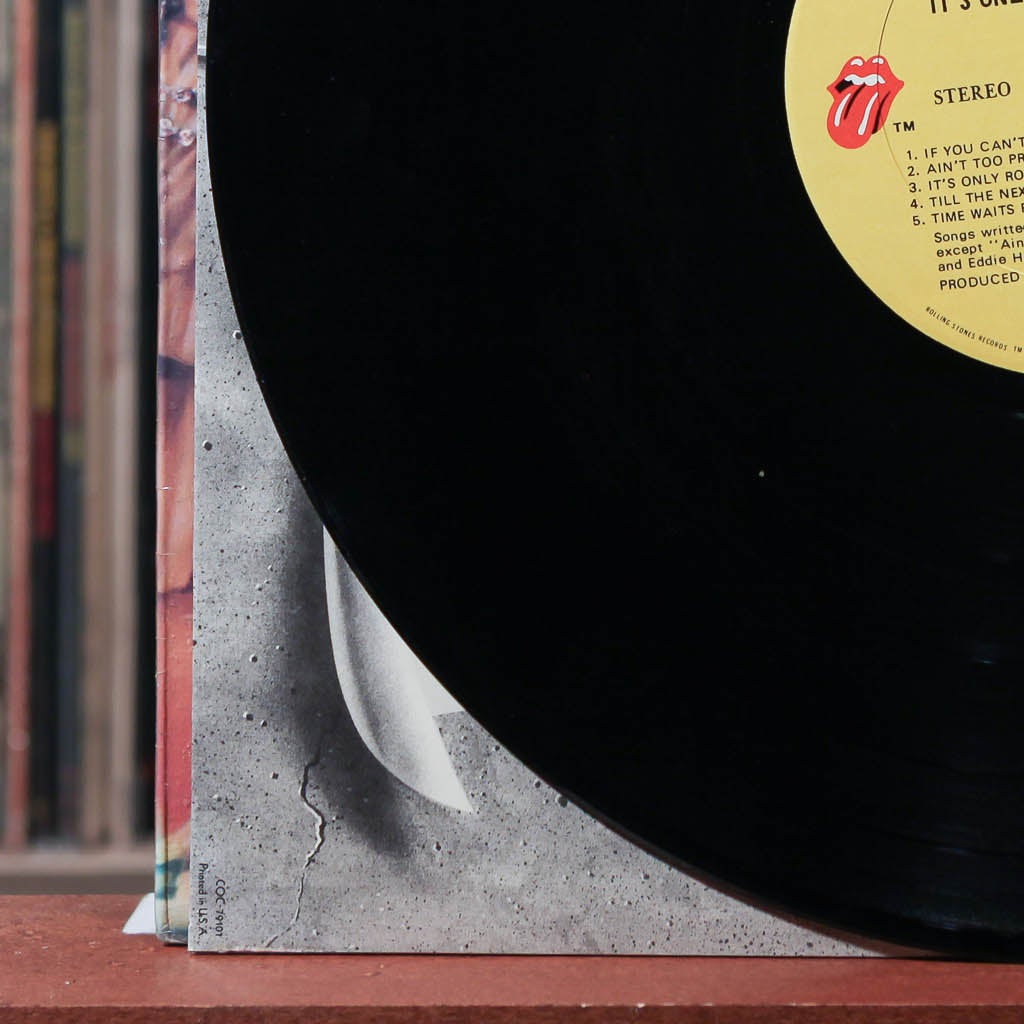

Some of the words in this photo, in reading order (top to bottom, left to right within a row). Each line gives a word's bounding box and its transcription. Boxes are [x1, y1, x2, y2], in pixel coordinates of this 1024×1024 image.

[934, 81, 1011, 105] STEREO
[893, 121, 915, 132] TM
[907, 150, 918, 160] 1.
[924, 147, 938, 158] IF
[943, 144, 973, 157] YOU
[907, 166, 920, 177] 2.
[927, 160, 967, 174] AIN'T
[975, 155, 1003, 169] TOO
[909, 182, 921, 193] 3.
[929, 178, 956, 191] IT'S
[962, 173, 999, 187] ONLY
[910, 198, 923, 210] 4.
[930, 195, 960, 208] TILL
[966, 190, 993, 203] THE
[912, 215, 925, 226] 5.
[932, 211, 965, 224] TIME
[970, 204, 1015, 219] WAITS
[934, 230, 975, 243] Songs
[936, 243, 983, 258] except
[938, 260, 962, 272] and
[969, 255, 1007, 268] Eddie
[940, 271, 1020, 290] PRODUCED
[926, 307, 950, 325] ROLLING
[952, 324, 975, 339] STONES
[978, 335, 1008, 351] RECORDS
